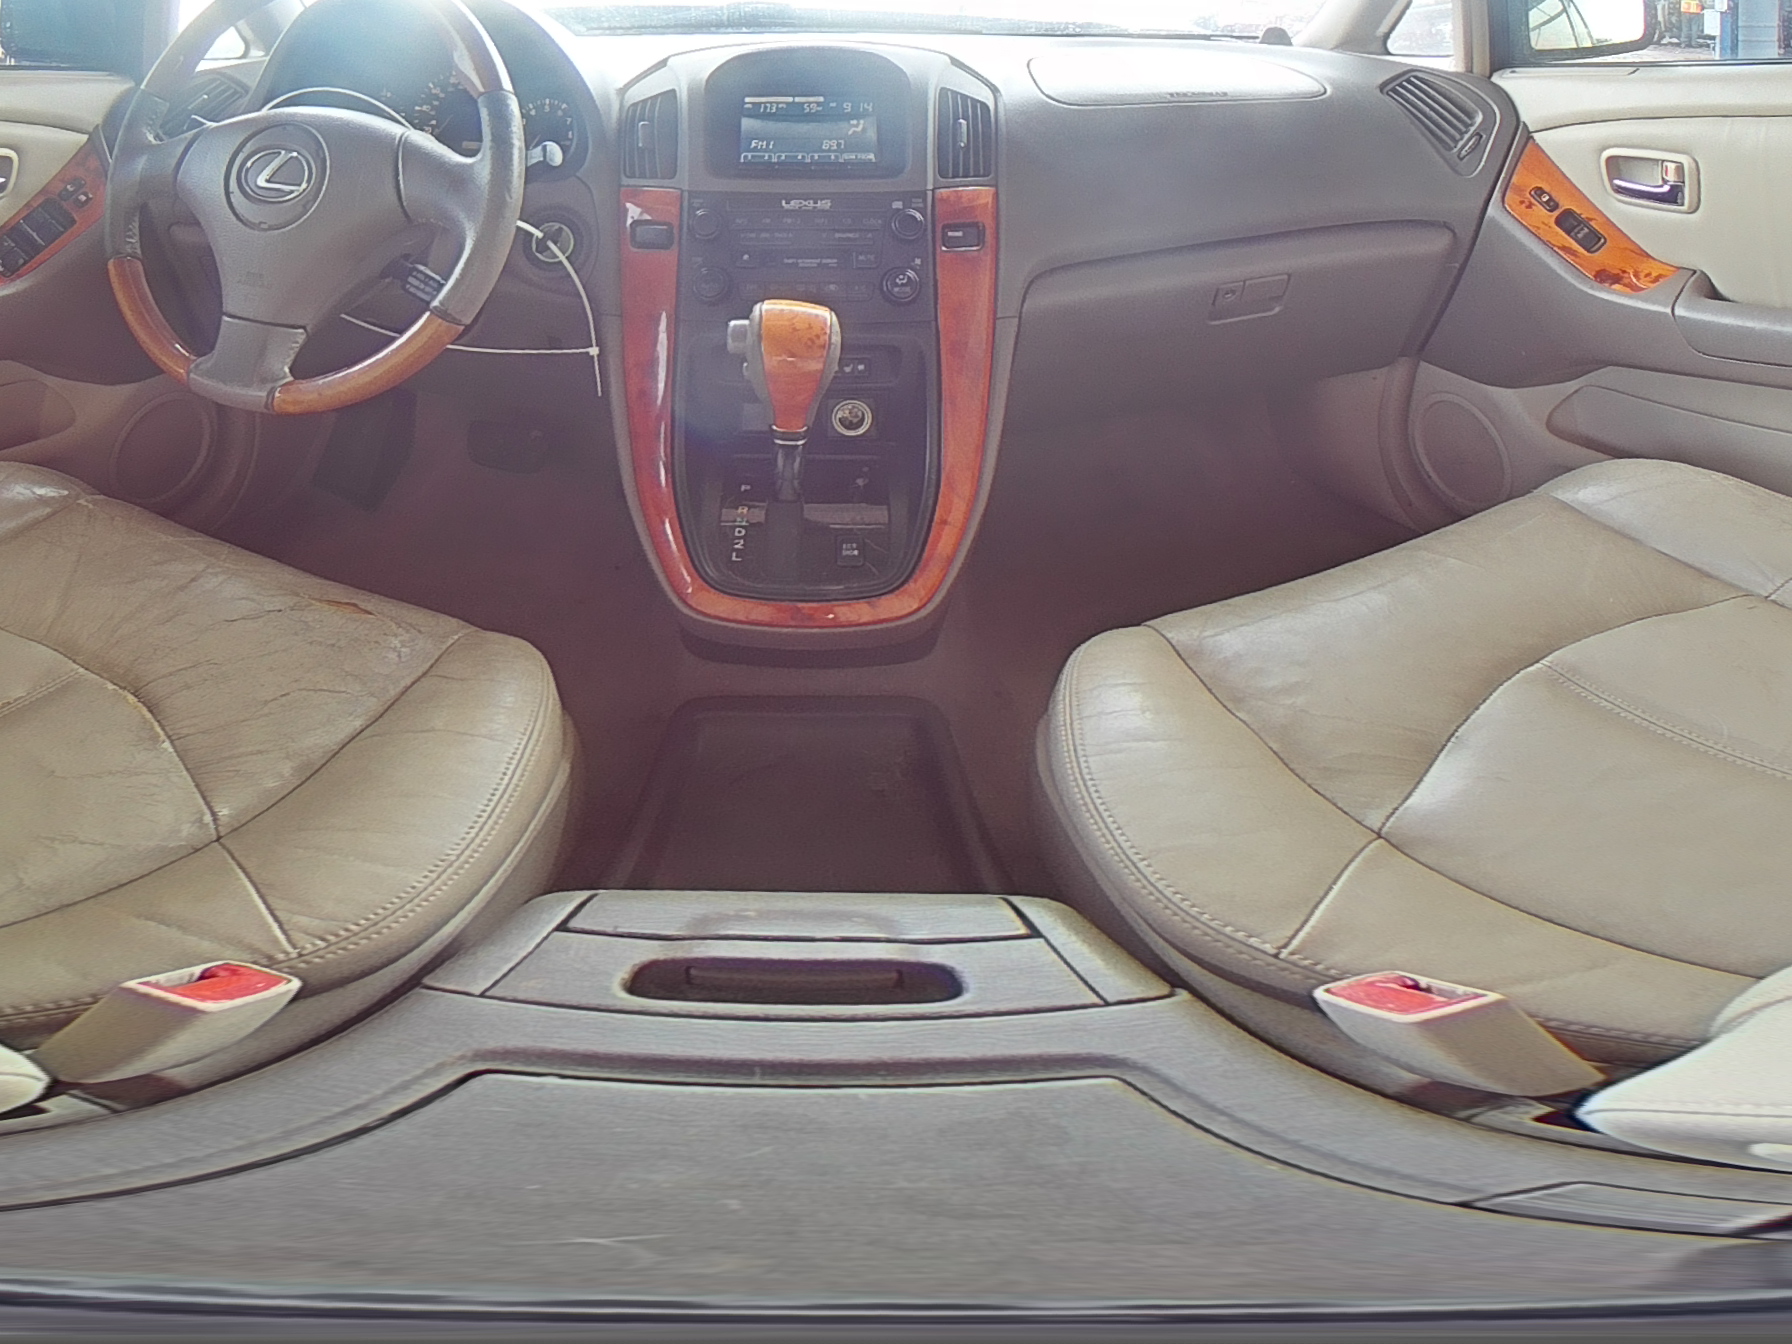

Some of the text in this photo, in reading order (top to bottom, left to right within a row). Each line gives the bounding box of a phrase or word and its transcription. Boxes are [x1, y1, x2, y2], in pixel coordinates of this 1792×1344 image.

[781, 199, 832, 208] LEXUS
[734, 528, 746, 536] D
[733, 540, 745, 549] 2
[731, 552, 742, 561] L
